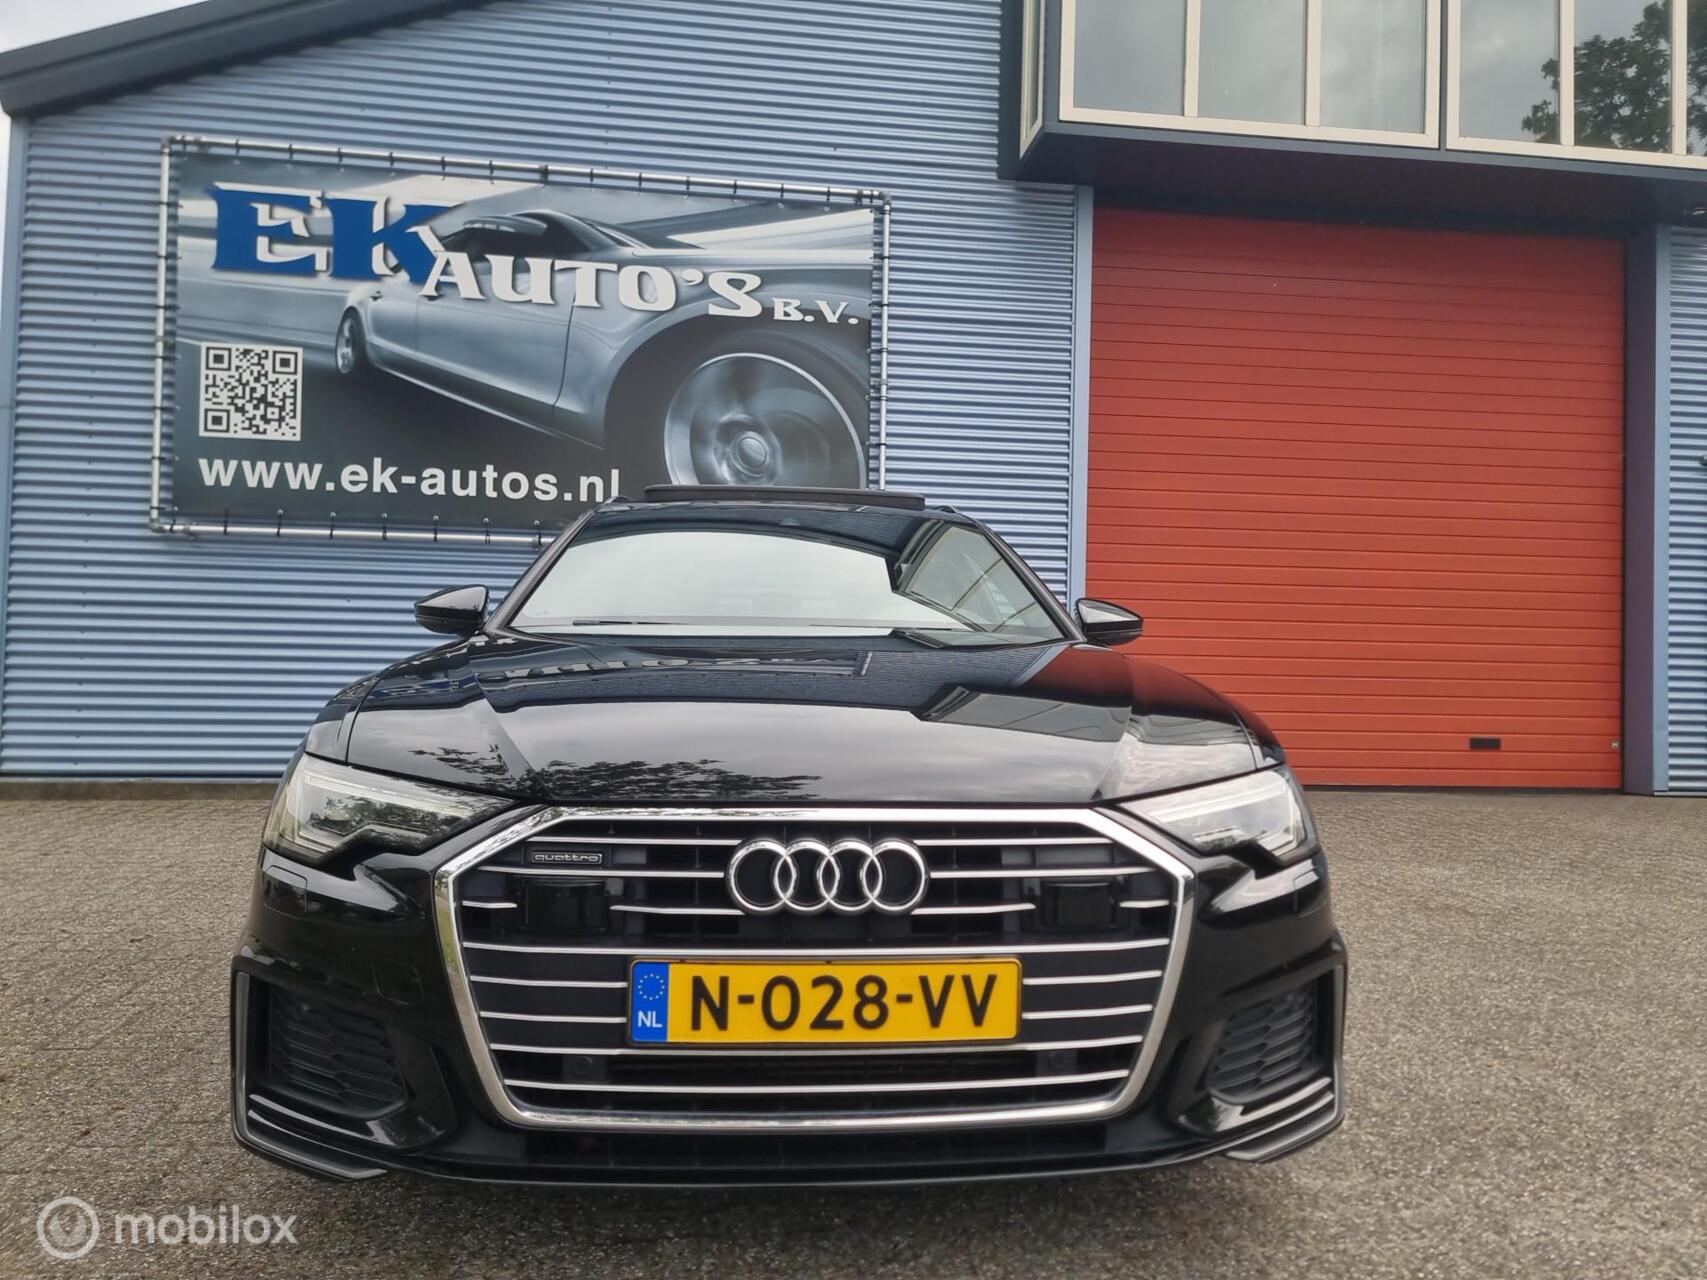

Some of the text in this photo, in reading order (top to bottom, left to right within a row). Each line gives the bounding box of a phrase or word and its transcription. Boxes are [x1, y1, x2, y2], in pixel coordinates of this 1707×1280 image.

[208, 182, 464, 286] EK
[772, 298, 859, 324] B.V.
[198, 457, 620, 503] www.ek-autos.nl
[534, 854, 599, 863] quattro
[637, 1010, 663, 1029] NL
[691, 974, 998, 1032] N-028-VV
